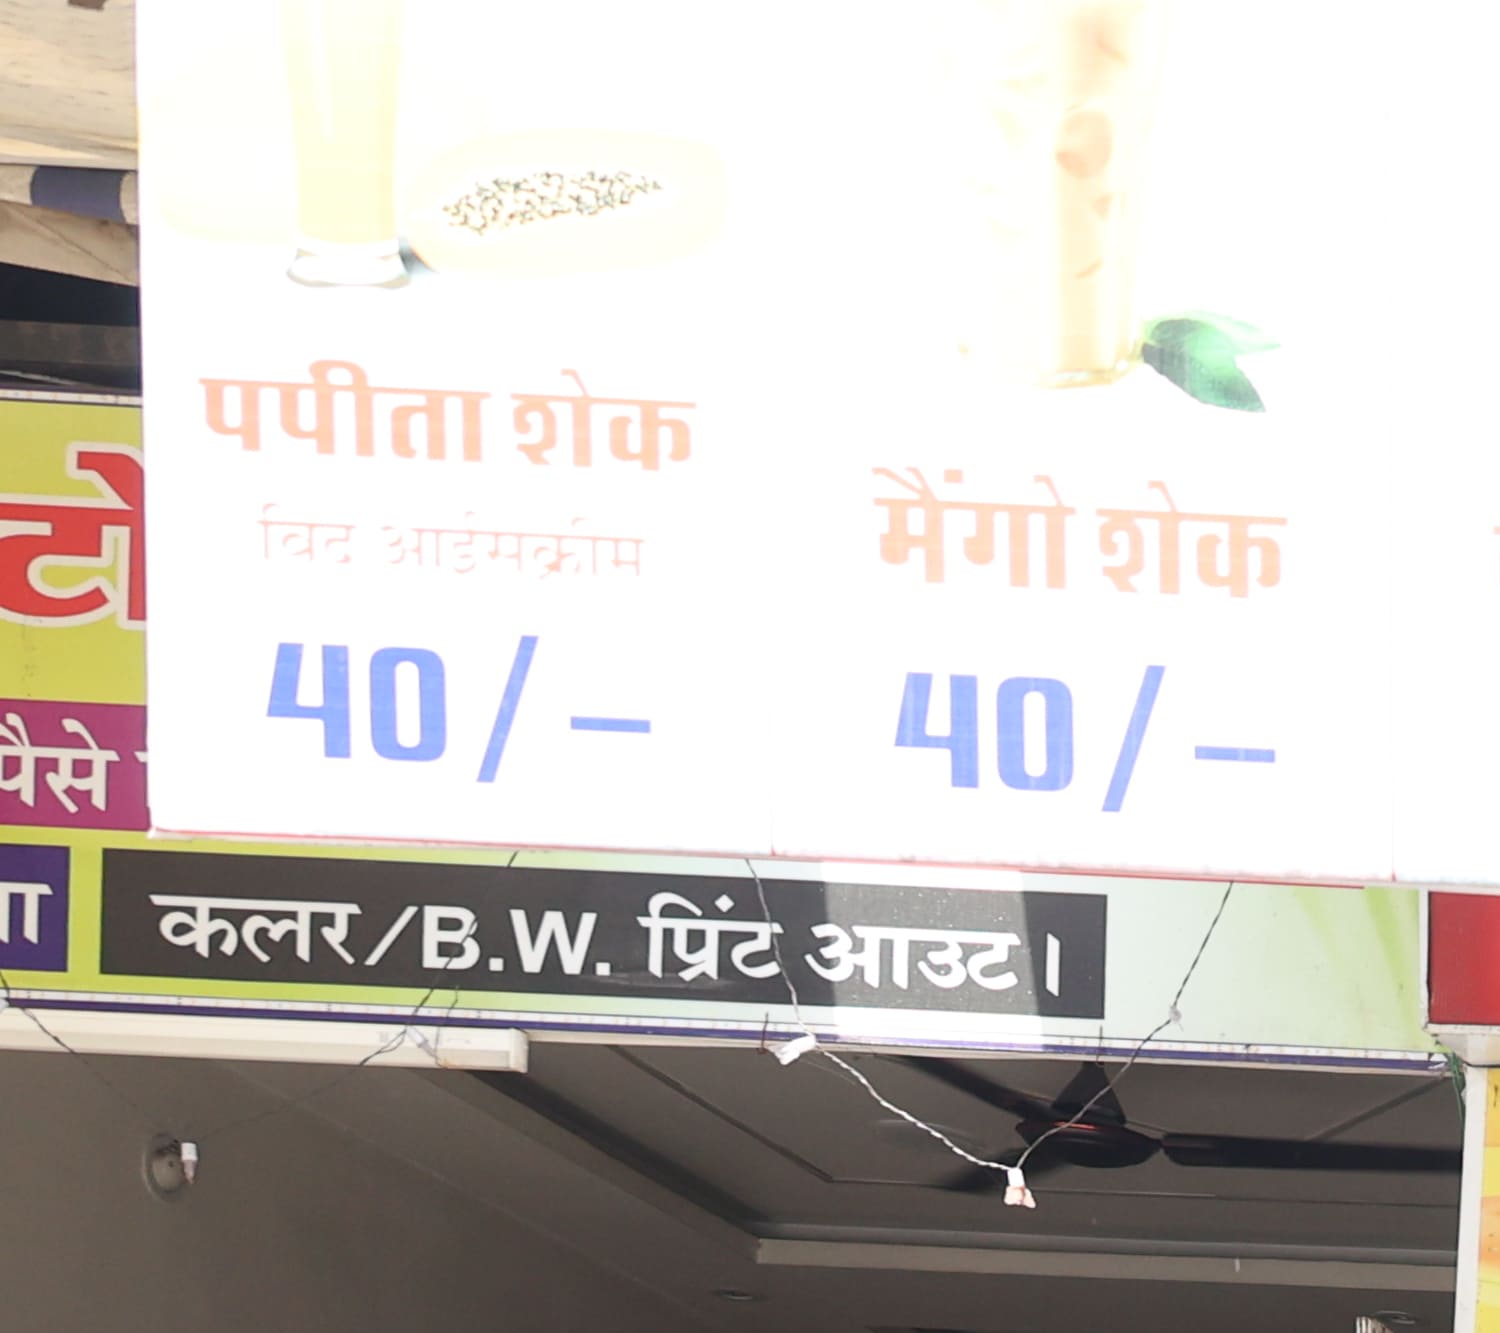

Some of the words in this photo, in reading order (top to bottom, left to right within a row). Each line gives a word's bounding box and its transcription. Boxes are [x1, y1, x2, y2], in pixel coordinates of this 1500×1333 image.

[199, 360, 490, 461] पपीता
[510, 369, 696, 472] शेक
[873, 466, 1075, 590] मैंगो
[1096, 480, 1287, 598] शेक
[641, 893, 782, 979] प्रिंट
